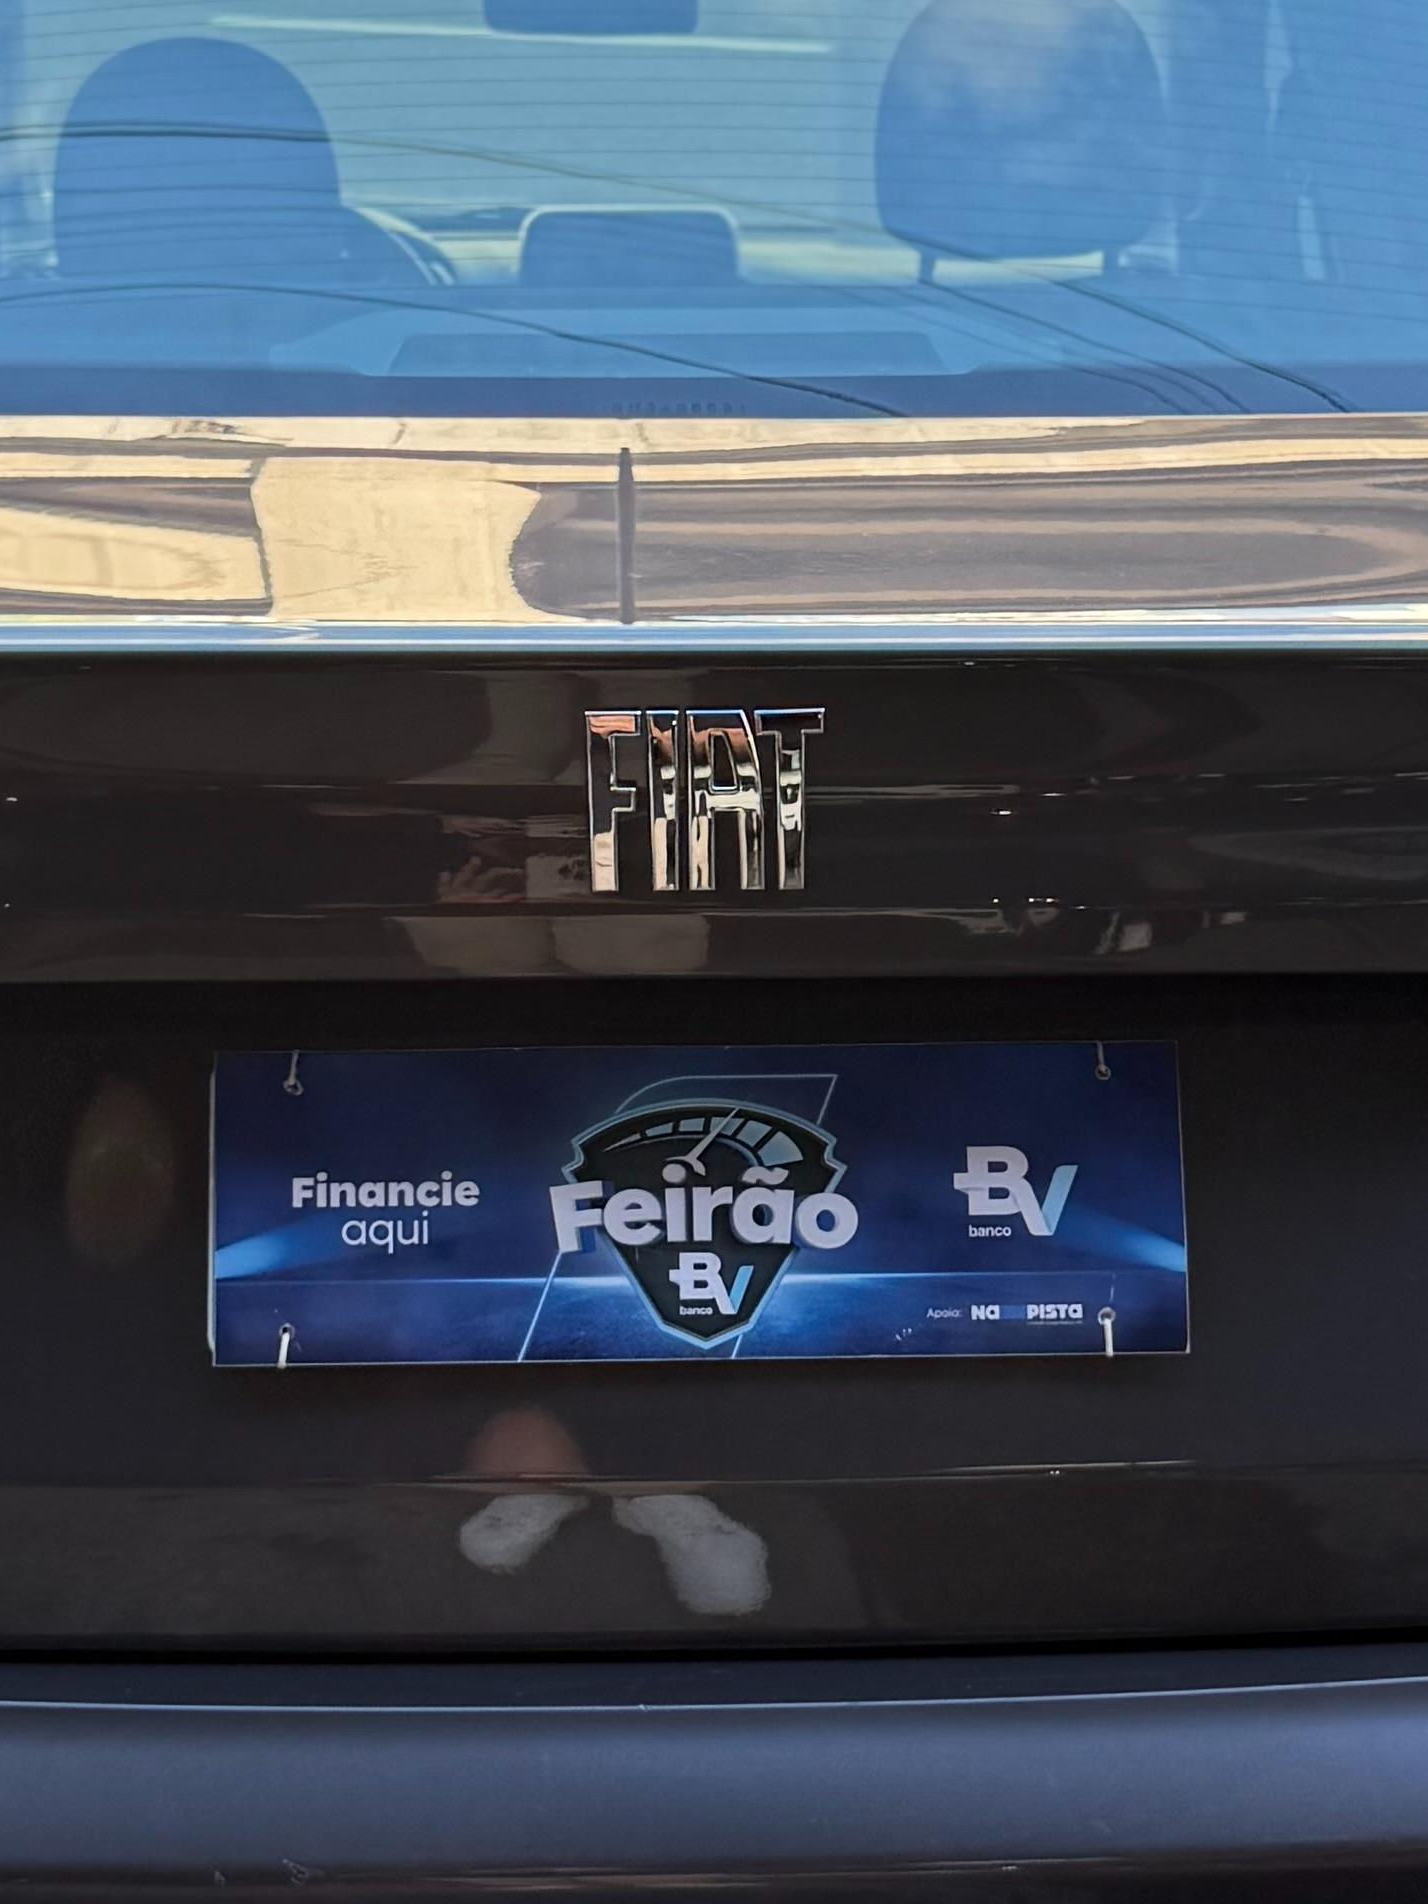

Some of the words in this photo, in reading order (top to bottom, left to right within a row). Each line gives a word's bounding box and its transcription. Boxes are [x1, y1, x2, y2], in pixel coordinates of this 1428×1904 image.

[585, 707, 825, 892] FIAT
[292, 1170, 481, 1208] Financie
[548, 1163, 859, 1253] Feirão
[953, 1145, 1078, 1236] BV
[341, 1210, 429, 1254] aqui
[968, 1225, 1012, 1237] banco
[668, 1251, 754, 1315] BV
[679, 1305, 714, 1316] banco
